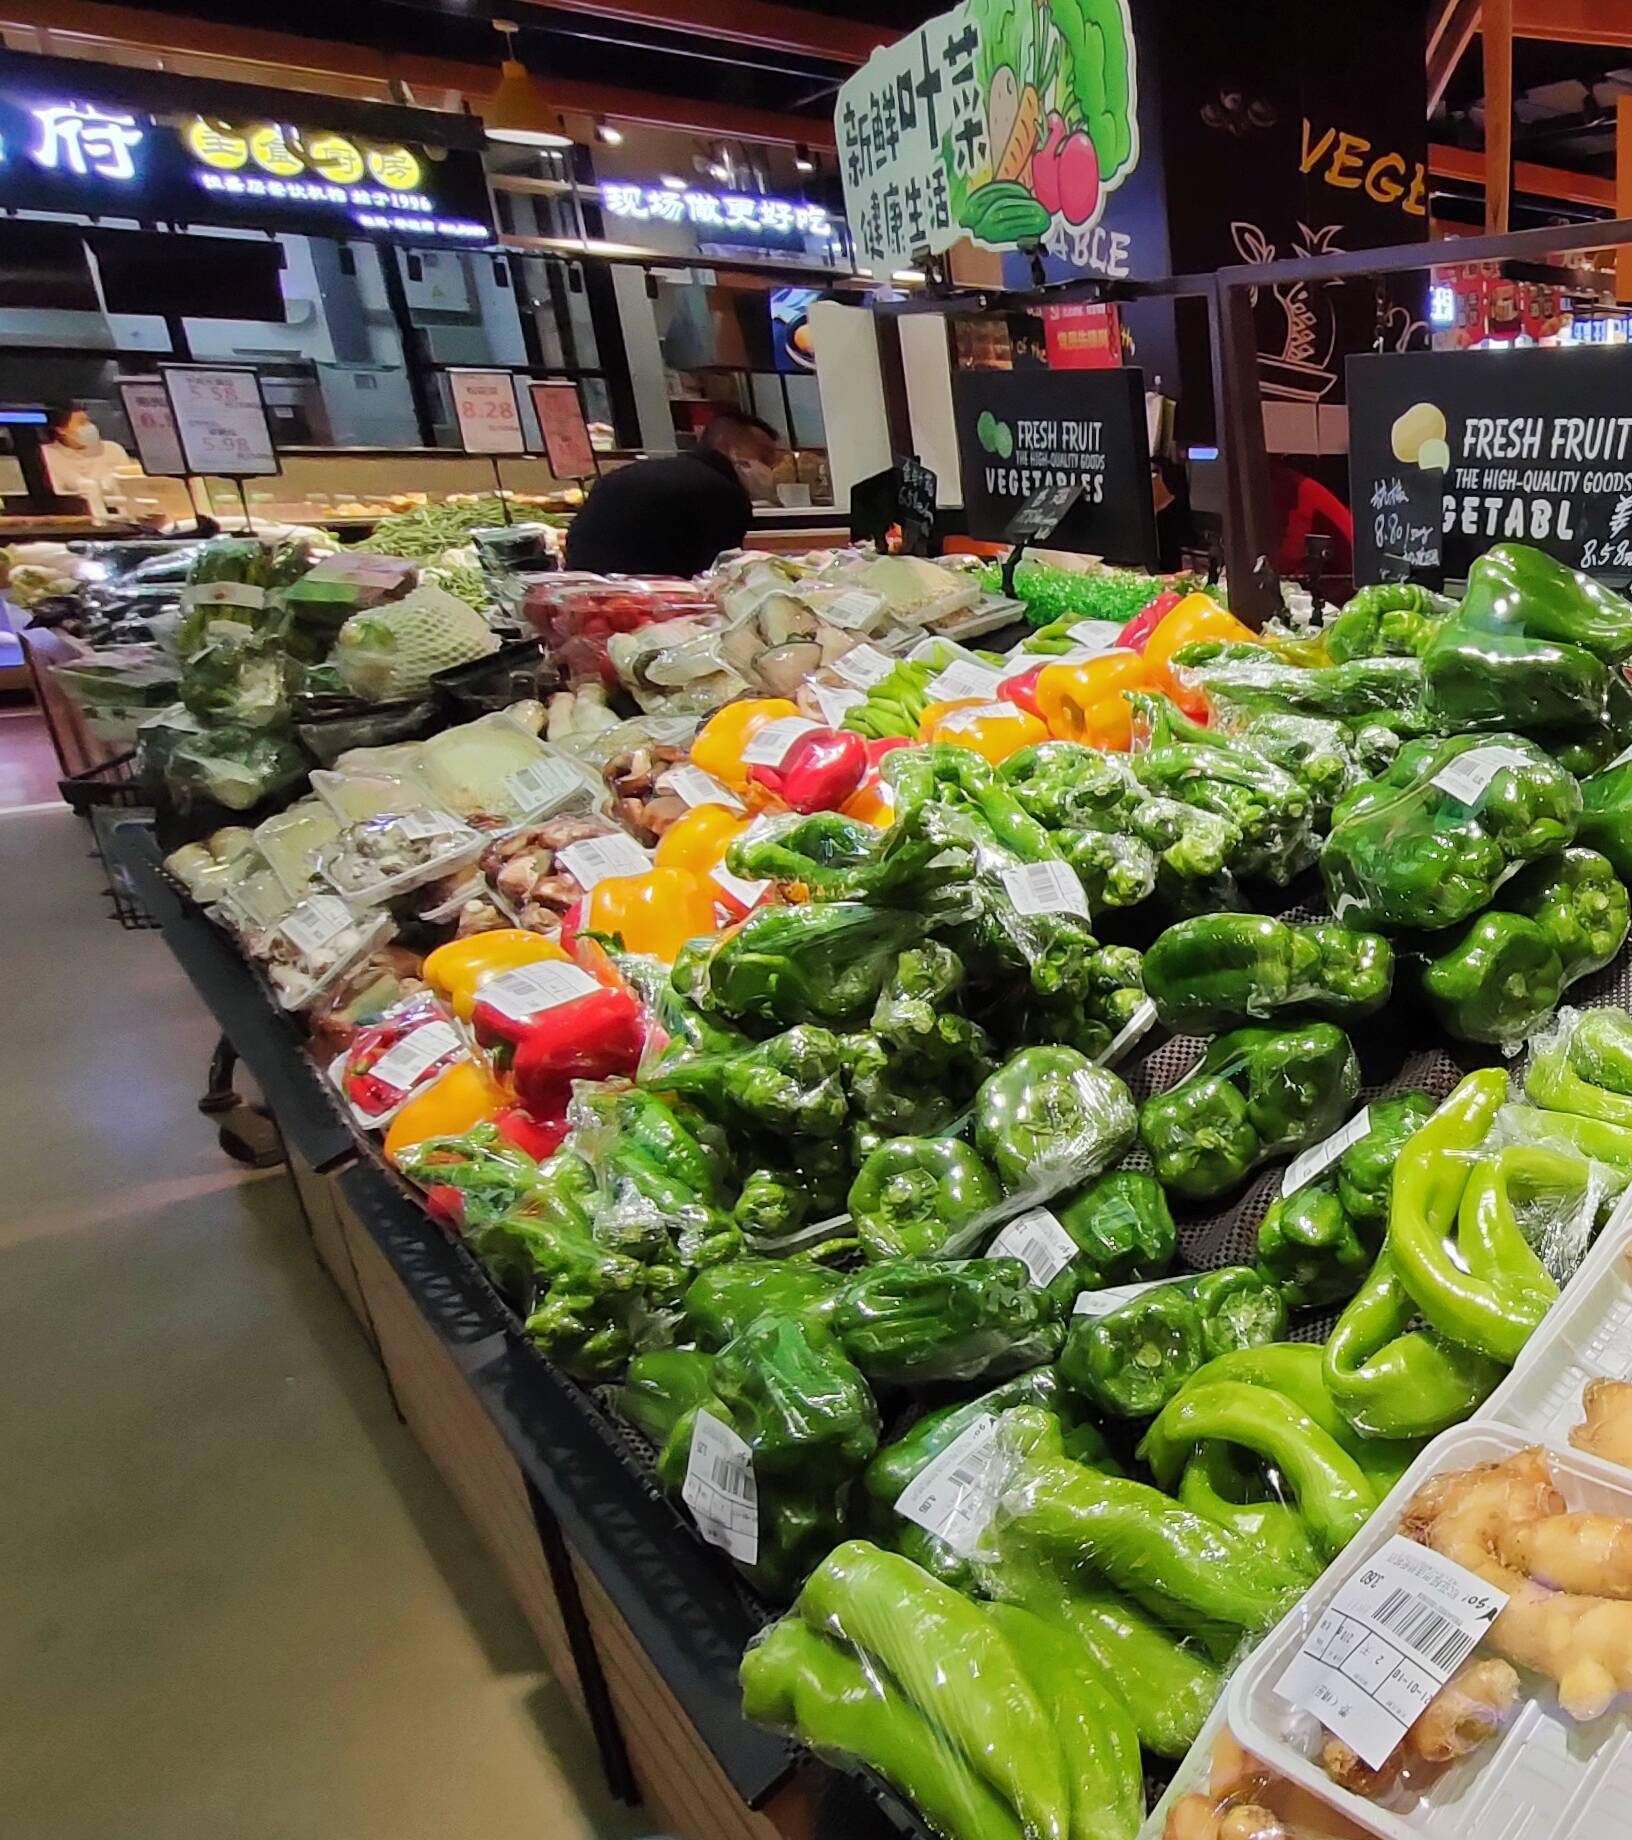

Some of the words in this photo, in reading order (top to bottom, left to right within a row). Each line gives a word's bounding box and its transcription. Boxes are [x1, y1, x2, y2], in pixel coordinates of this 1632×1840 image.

[843, 24, 987, 187] 新鲜叶菜
[32, 101, 143, 180] 府
[602, 185, 832, 238] 现场做更好吃
[860, 166, 950, 260] 健康生活
[1016, 420, 1057, 451] FRESH
[1062, 420, 1103, 451] FRUIT
[1463, 417, 1542, 461] FRESH
[1455, 467, 1481, 490] THE
[1483, 468, 1581, 494] HIGH-QUALITY
